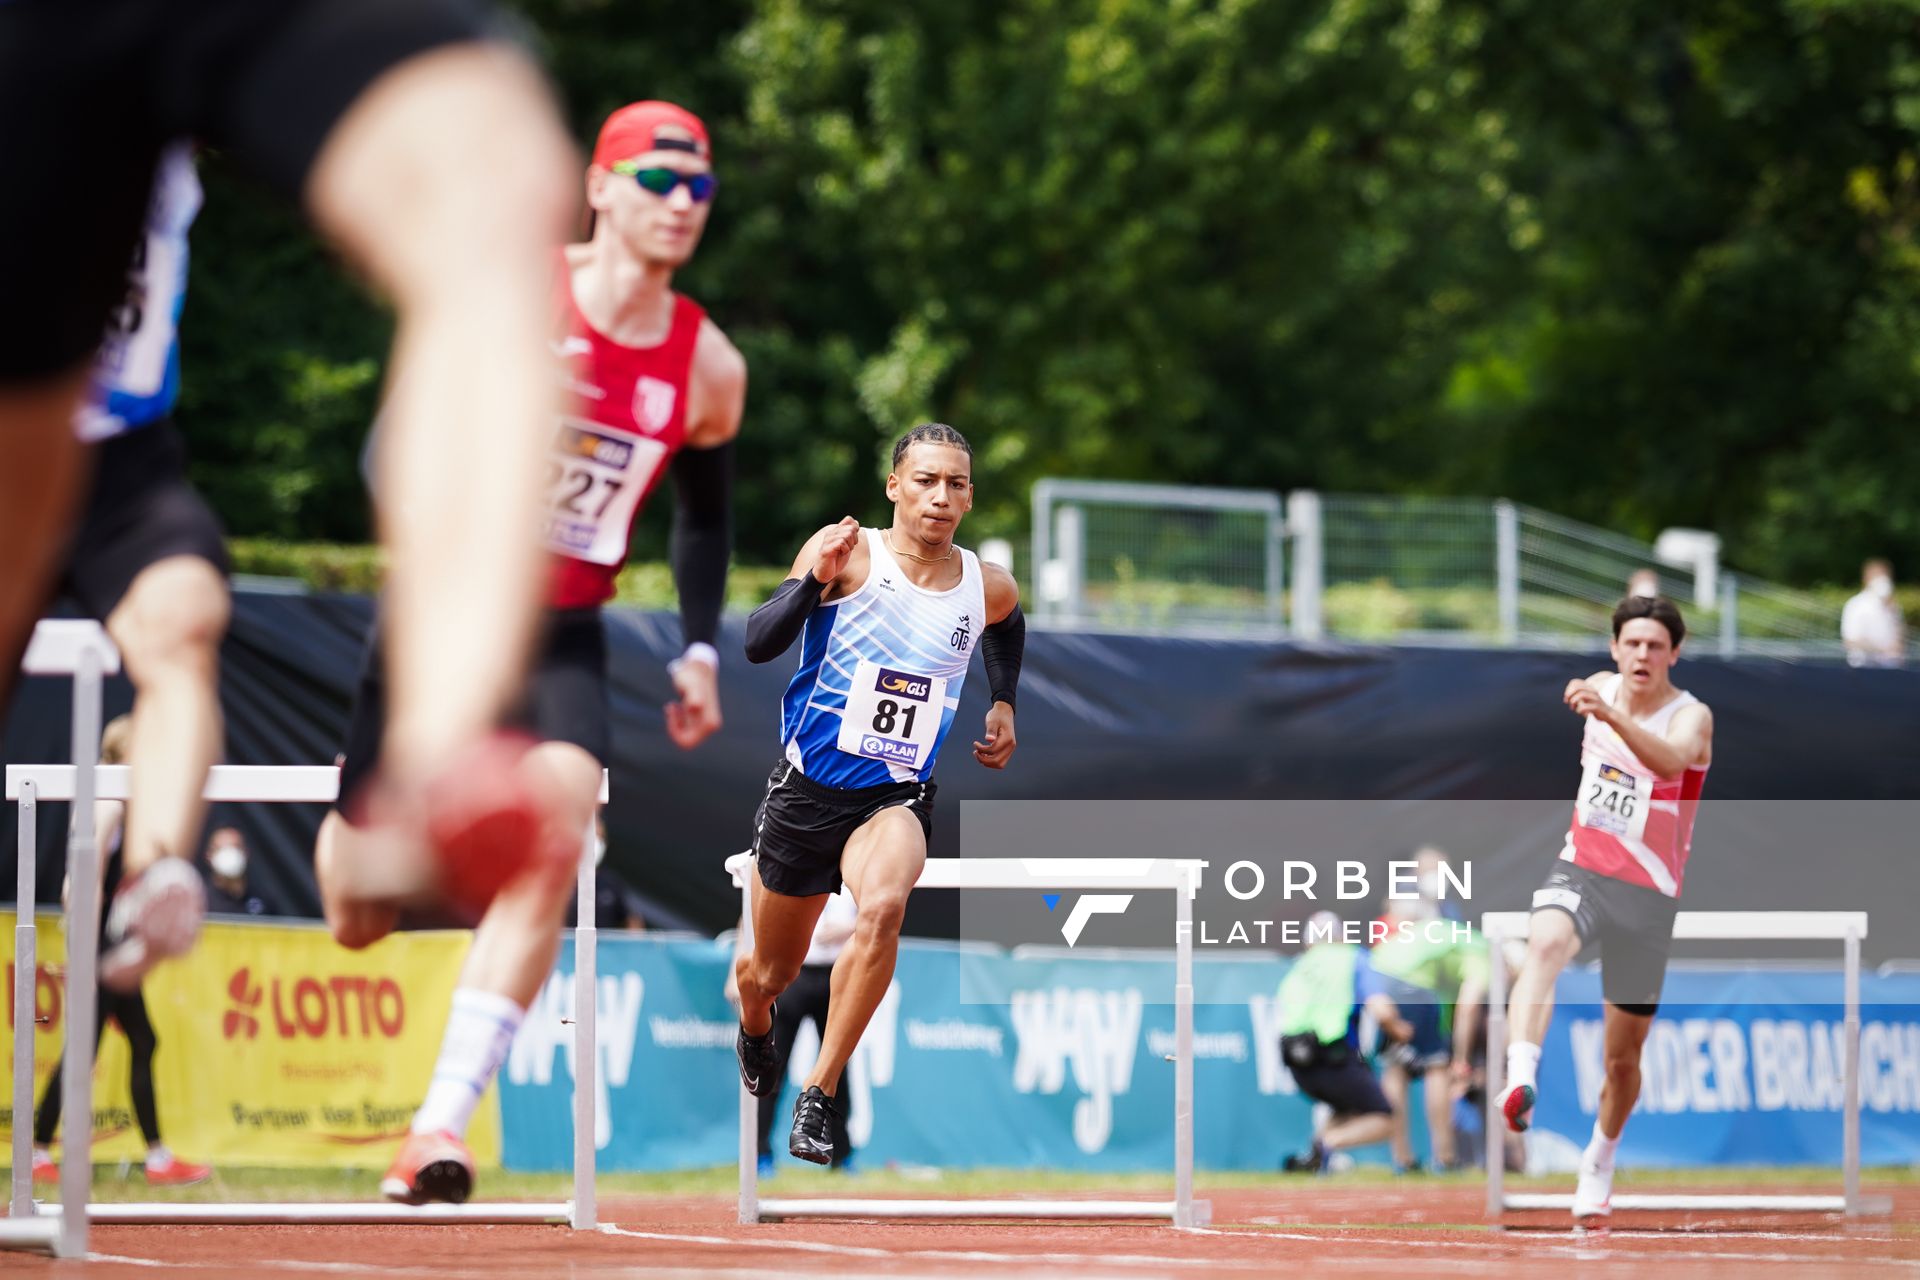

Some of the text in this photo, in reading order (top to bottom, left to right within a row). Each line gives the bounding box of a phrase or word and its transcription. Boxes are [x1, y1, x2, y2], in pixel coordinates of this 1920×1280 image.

[906, 682, 928, 697] GLS
[872, 699, 917, 739] 81
[884, 742, 916, 758] PLAN
[1588, 783, 1637, 818] 246
[271, 976, 405, 1039] LOTTO
